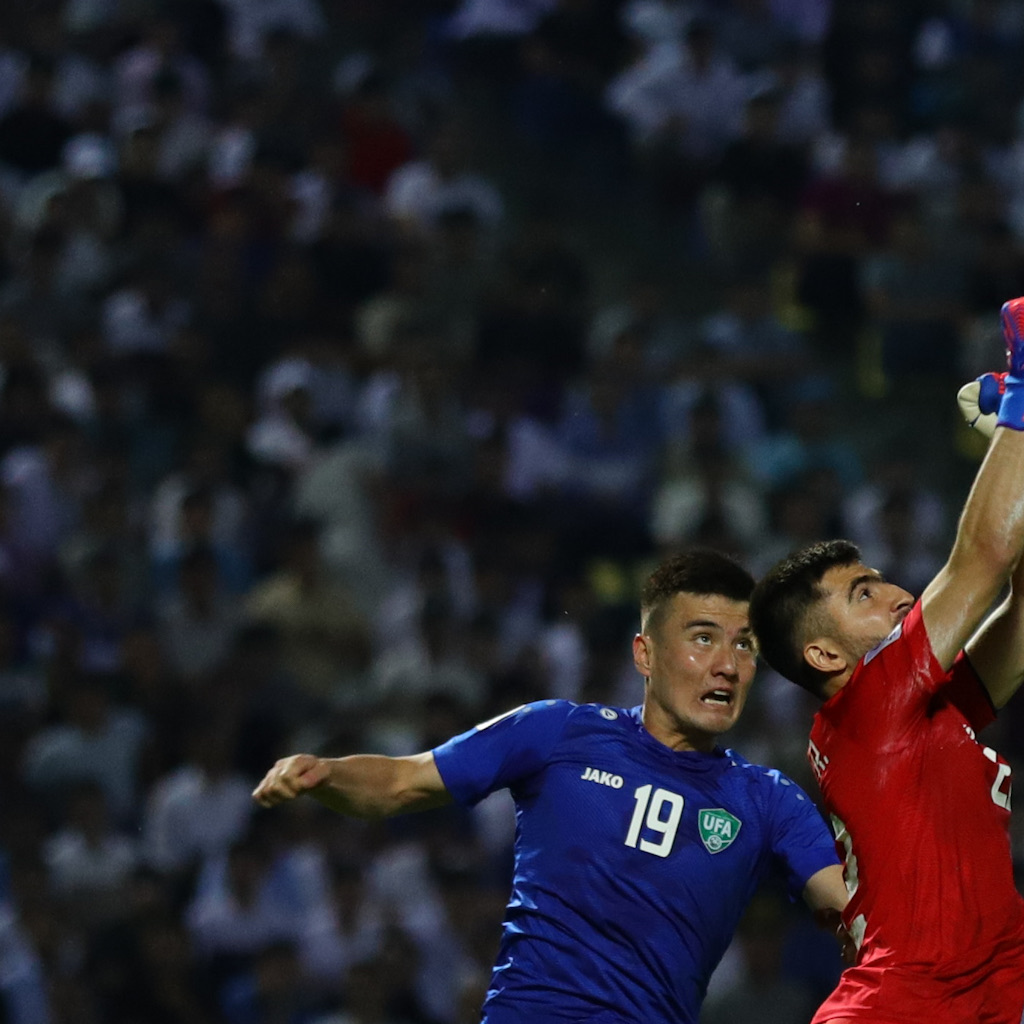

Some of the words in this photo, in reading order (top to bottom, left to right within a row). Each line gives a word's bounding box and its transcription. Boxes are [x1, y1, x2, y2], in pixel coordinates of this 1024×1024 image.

[581, 767, 624, 789] JAKO
[982, 746, 1012, 812] 2
[624, 784, 684, 858] 19
[703, 814, 732, 838] UFA
